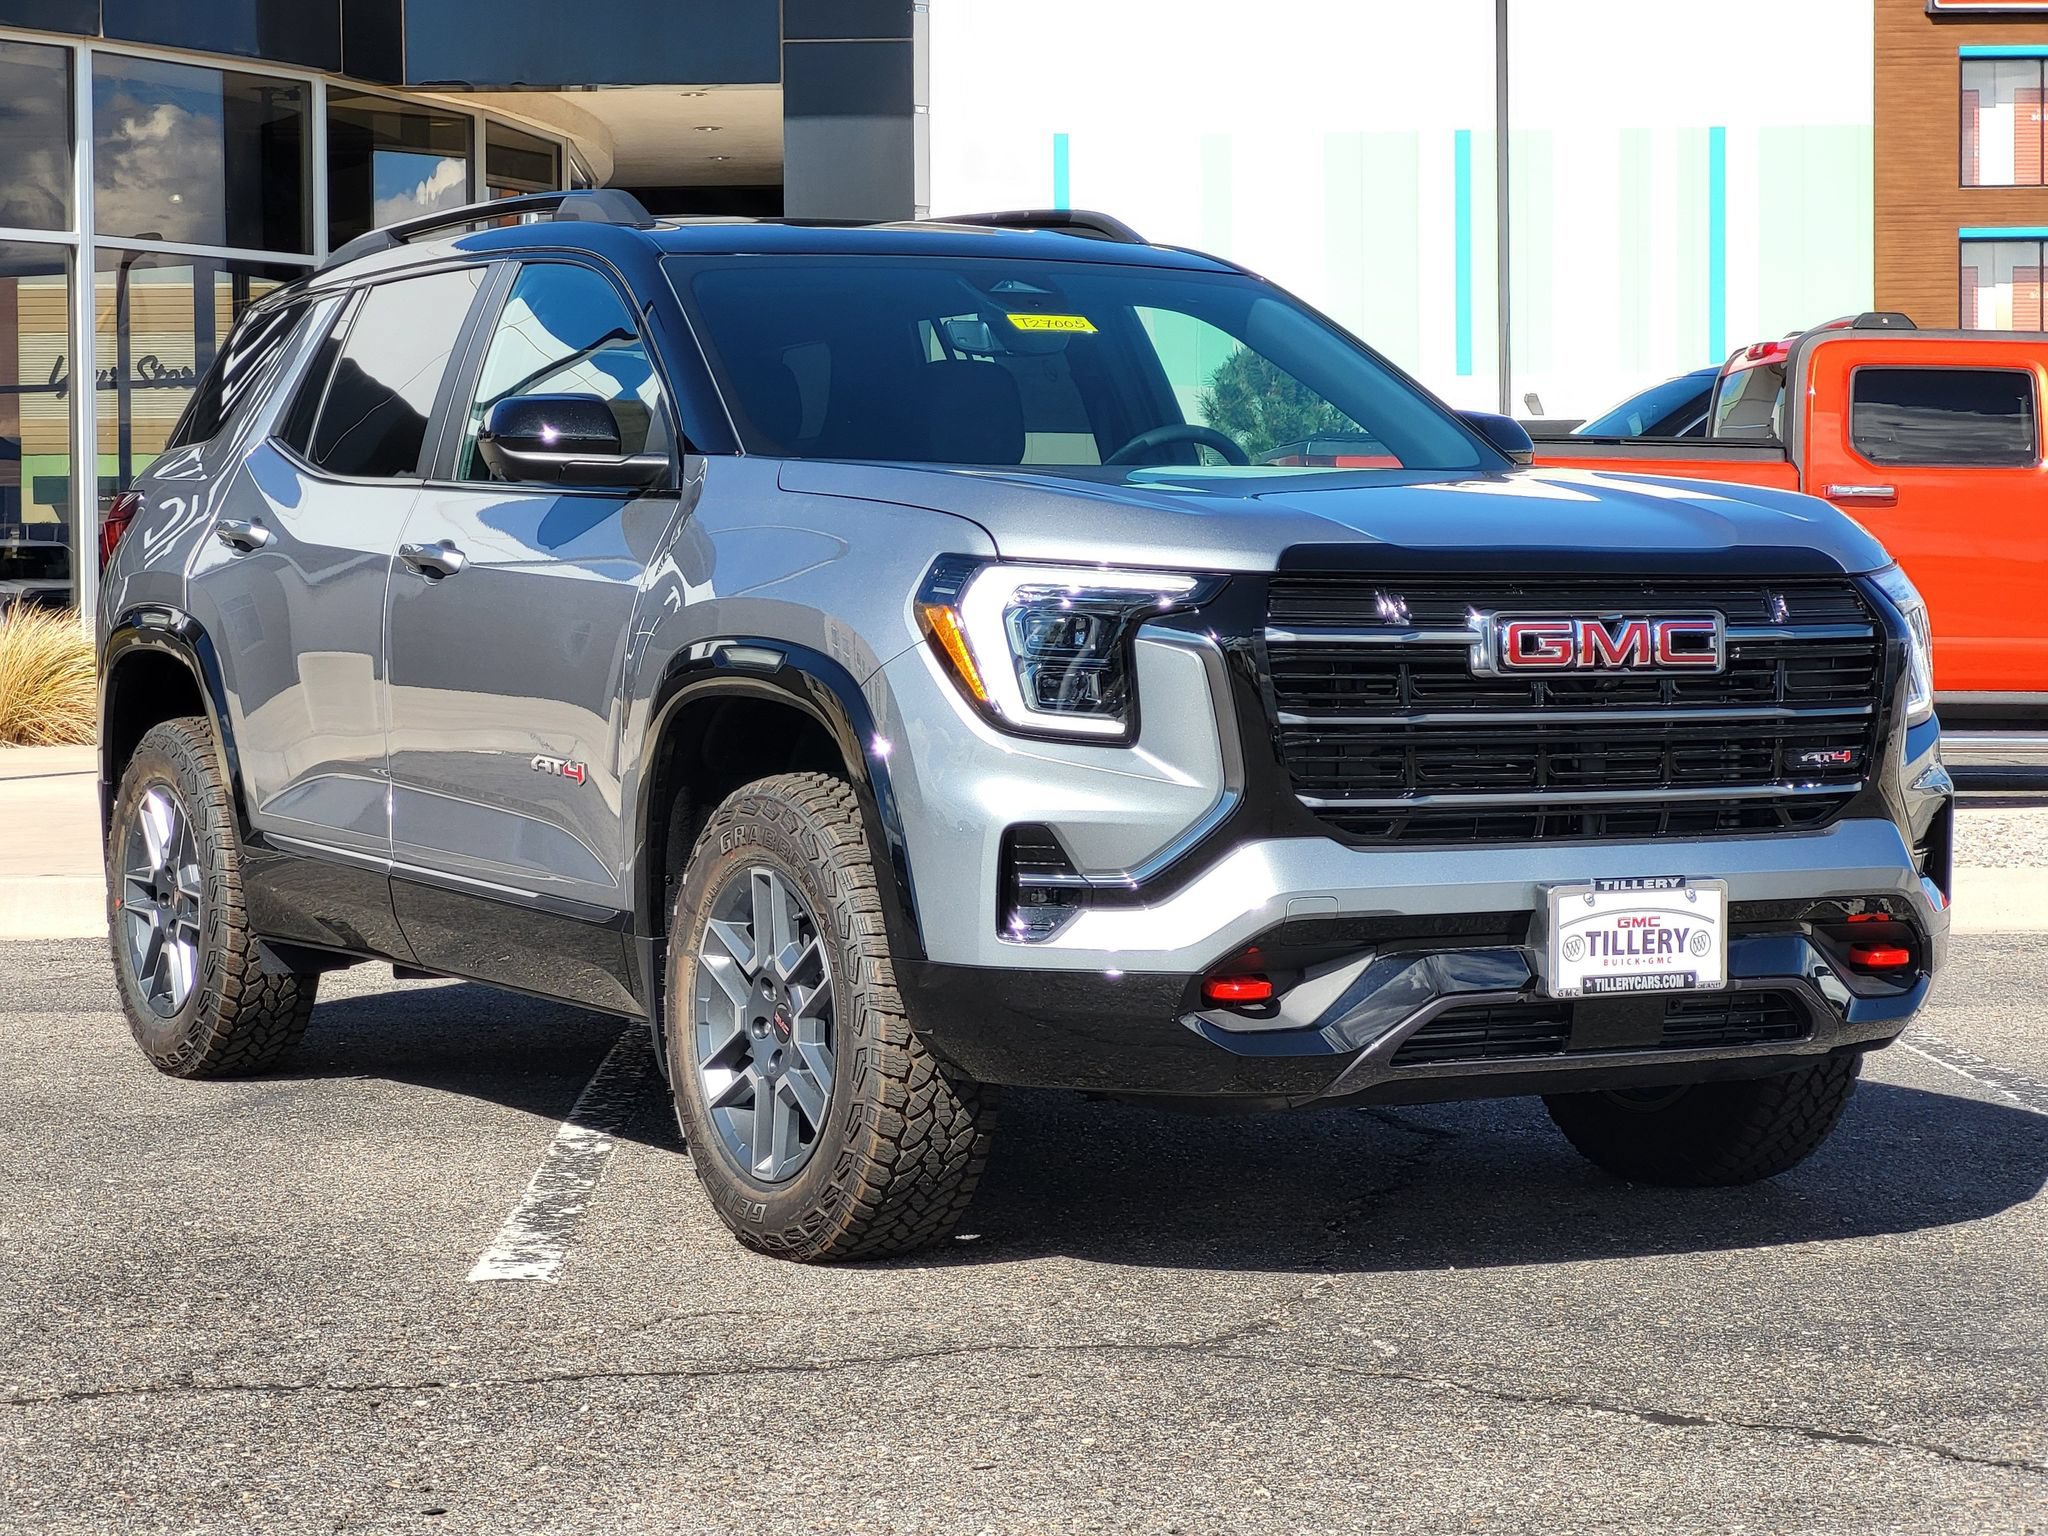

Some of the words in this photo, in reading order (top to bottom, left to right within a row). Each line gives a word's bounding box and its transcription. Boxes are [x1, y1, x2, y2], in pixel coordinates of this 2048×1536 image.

[1502, 619, 1718, 668] GMC
[1801, 750, 1851, 763] AT4
[531, 754, 587, 786] AT4
[719, 823, 818, 899] GRABBER
[1601, 877, 1682, 891] TILLERY
[1617, 915, 1661, 929] GMC
[1585, 927, 1691, 957] TILLERY
[1557, 988, 1580, 997] GMC
[1594, 972, 1685, 992] TILLERYCARS.COM
[774, 1010, 790, 1036] GMC
[682, 1096, 768, 1225] GENERAL
